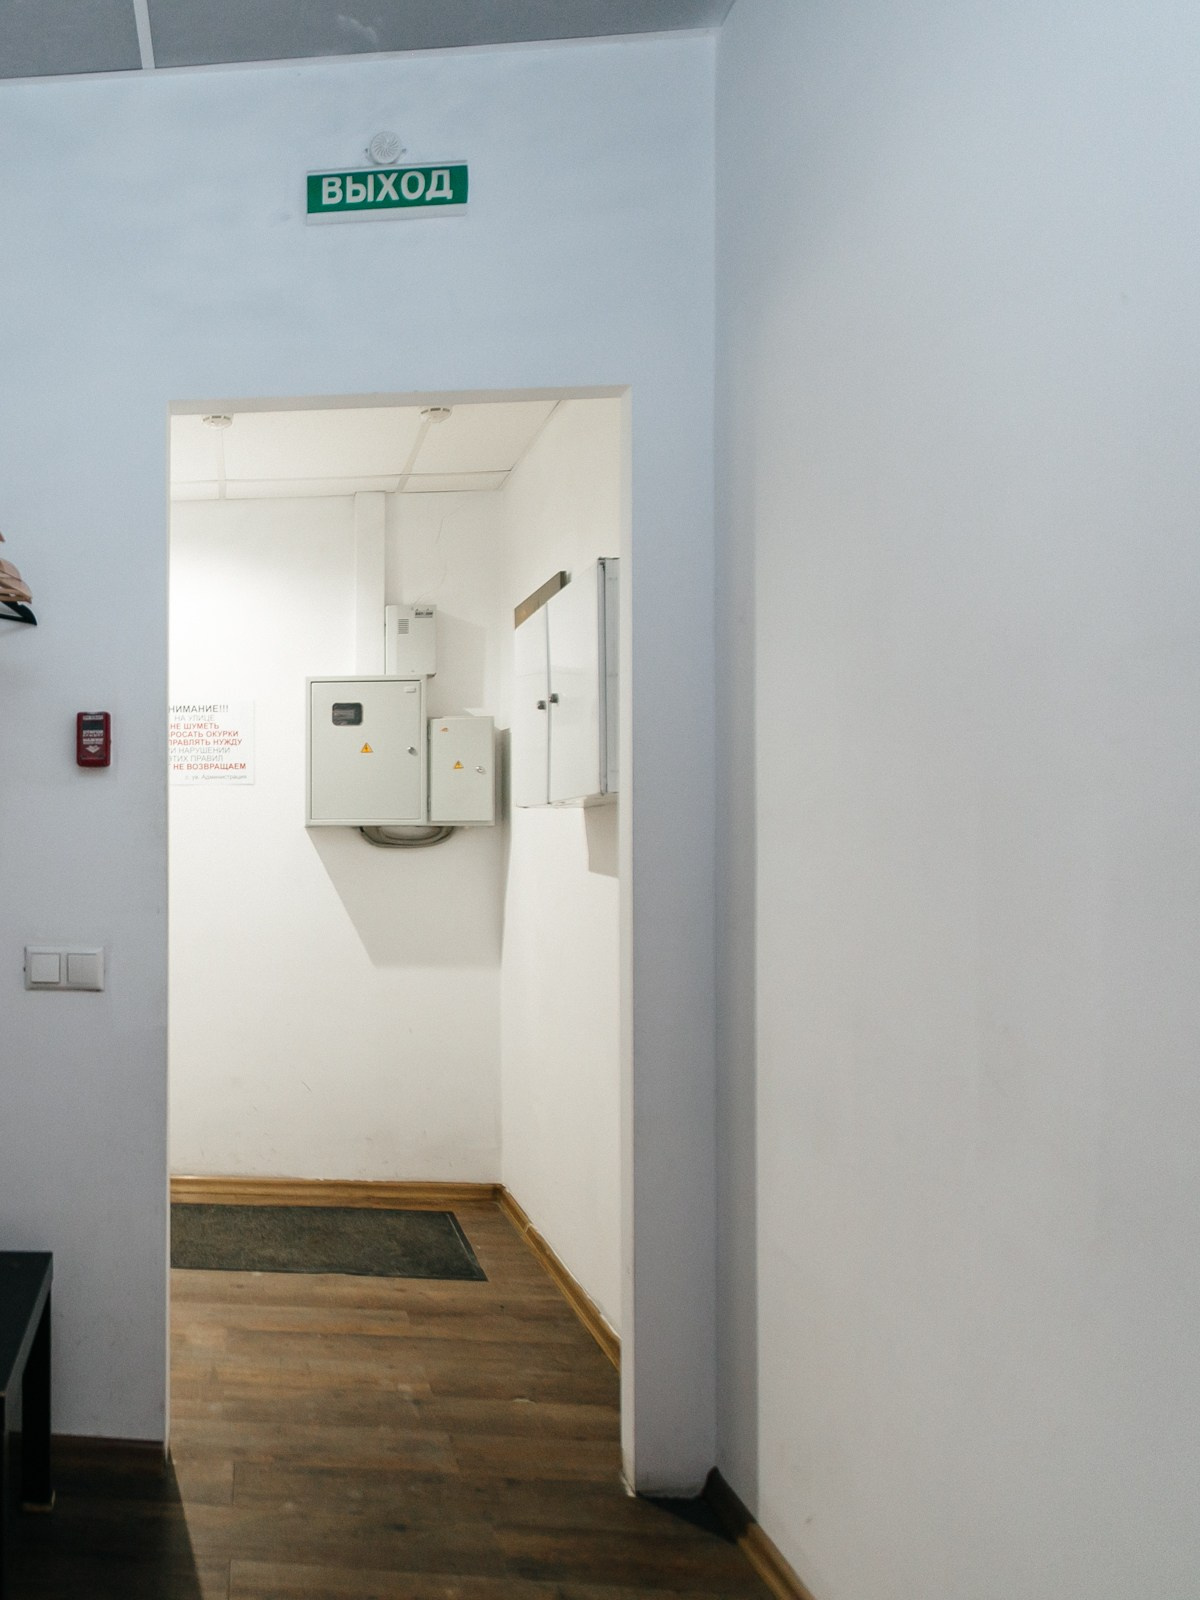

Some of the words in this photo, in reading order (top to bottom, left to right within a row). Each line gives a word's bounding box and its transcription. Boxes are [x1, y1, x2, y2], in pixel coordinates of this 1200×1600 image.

[321, 169, 454, 206] ВЫХОД
[168, 705, 229, 713] НИМАНИЕ!!!
[187, 763, 247, 771] ВОЗВРАЩАЕМ
